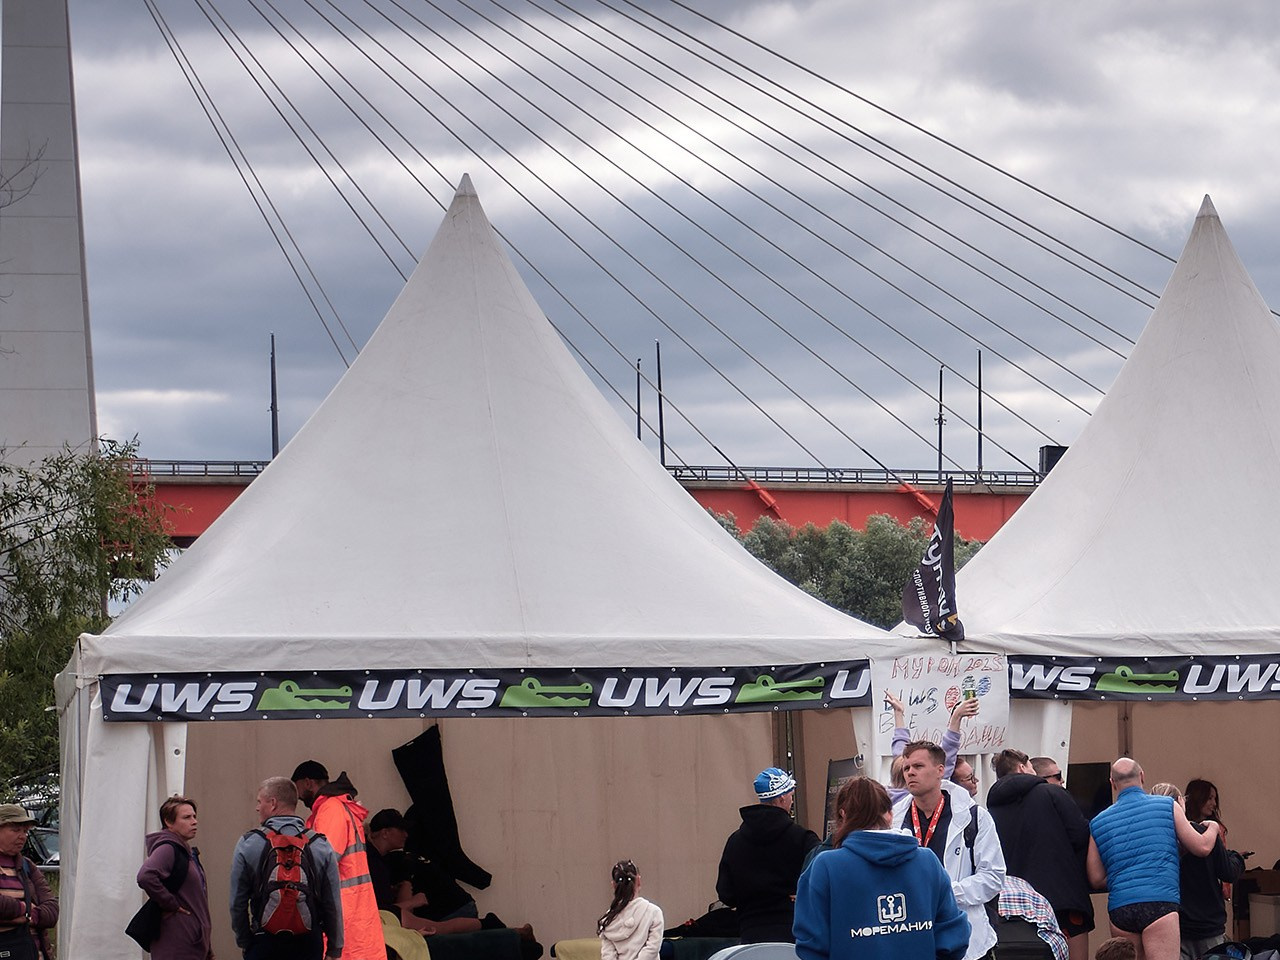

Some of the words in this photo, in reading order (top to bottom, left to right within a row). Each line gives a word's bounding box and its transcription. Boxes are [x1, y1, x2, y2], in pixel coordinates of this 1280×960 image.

[964, 655, 1004, 673] 2025
[1010, 664, 1098, 691] WS
[110, 681, 257, 714] UWS
[357, 678, 501, 710] UWS
[597, 676, 736, 708] UWS
[879, 713, 918, 734] ВЕ
[850, 920, 933, 938] МОРЕМАНИЯ
